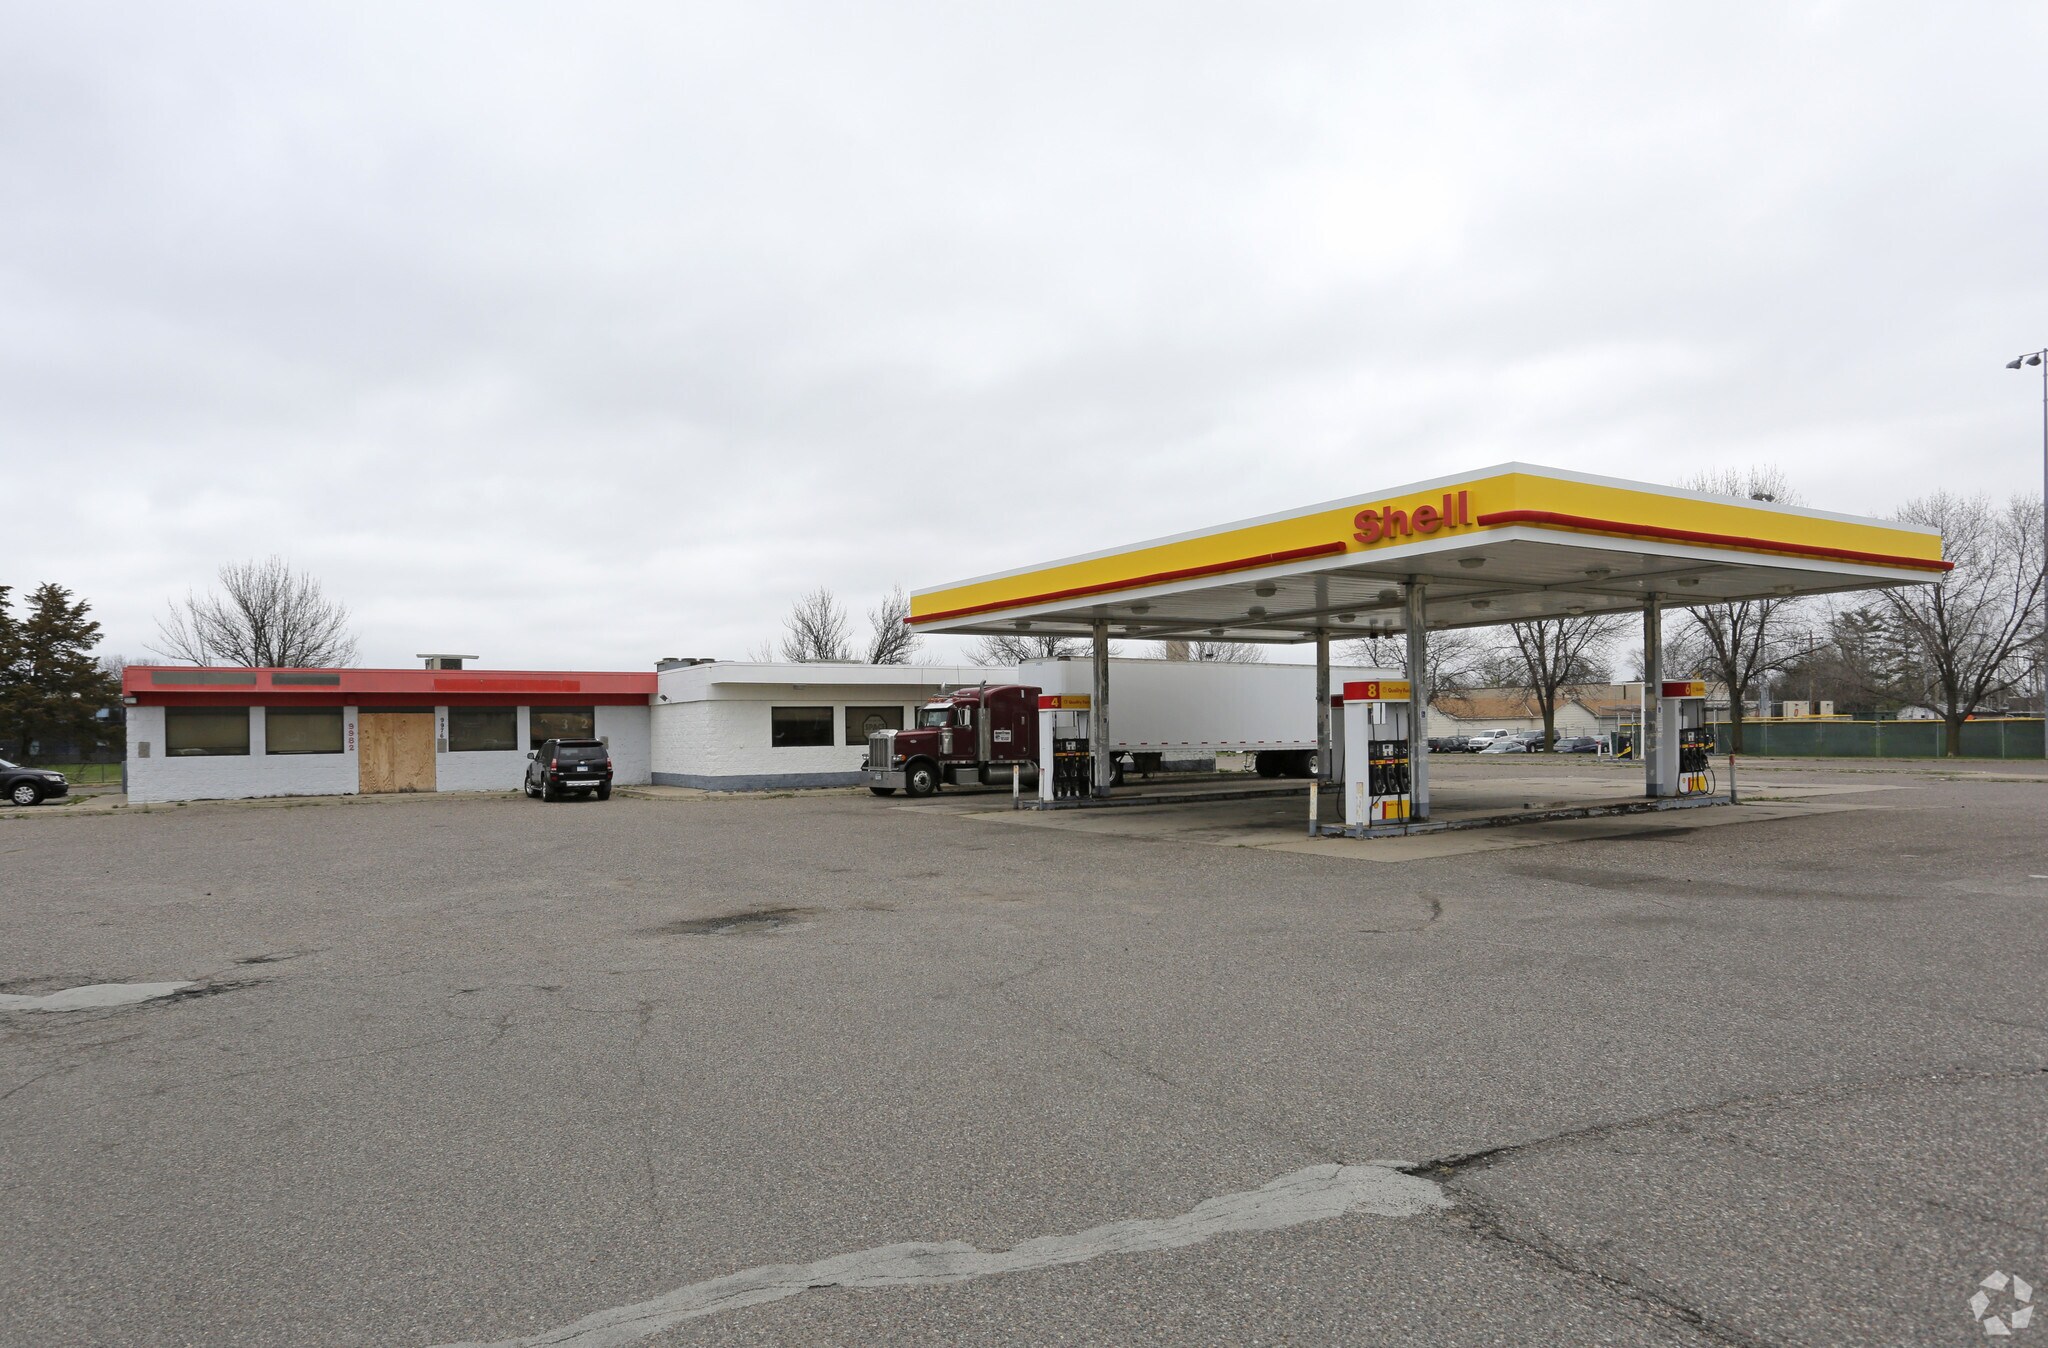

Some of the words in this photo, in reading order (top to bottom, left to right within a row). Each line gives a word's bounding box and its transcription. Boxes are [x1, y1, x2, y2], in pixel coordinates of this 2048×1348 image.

[1353, 490, 1468, 544] Shell
[1367, 683, 1377, 698] 8
[1685, 684, 1691, 695] 6
[1051, 697, 1059, 707] 4
